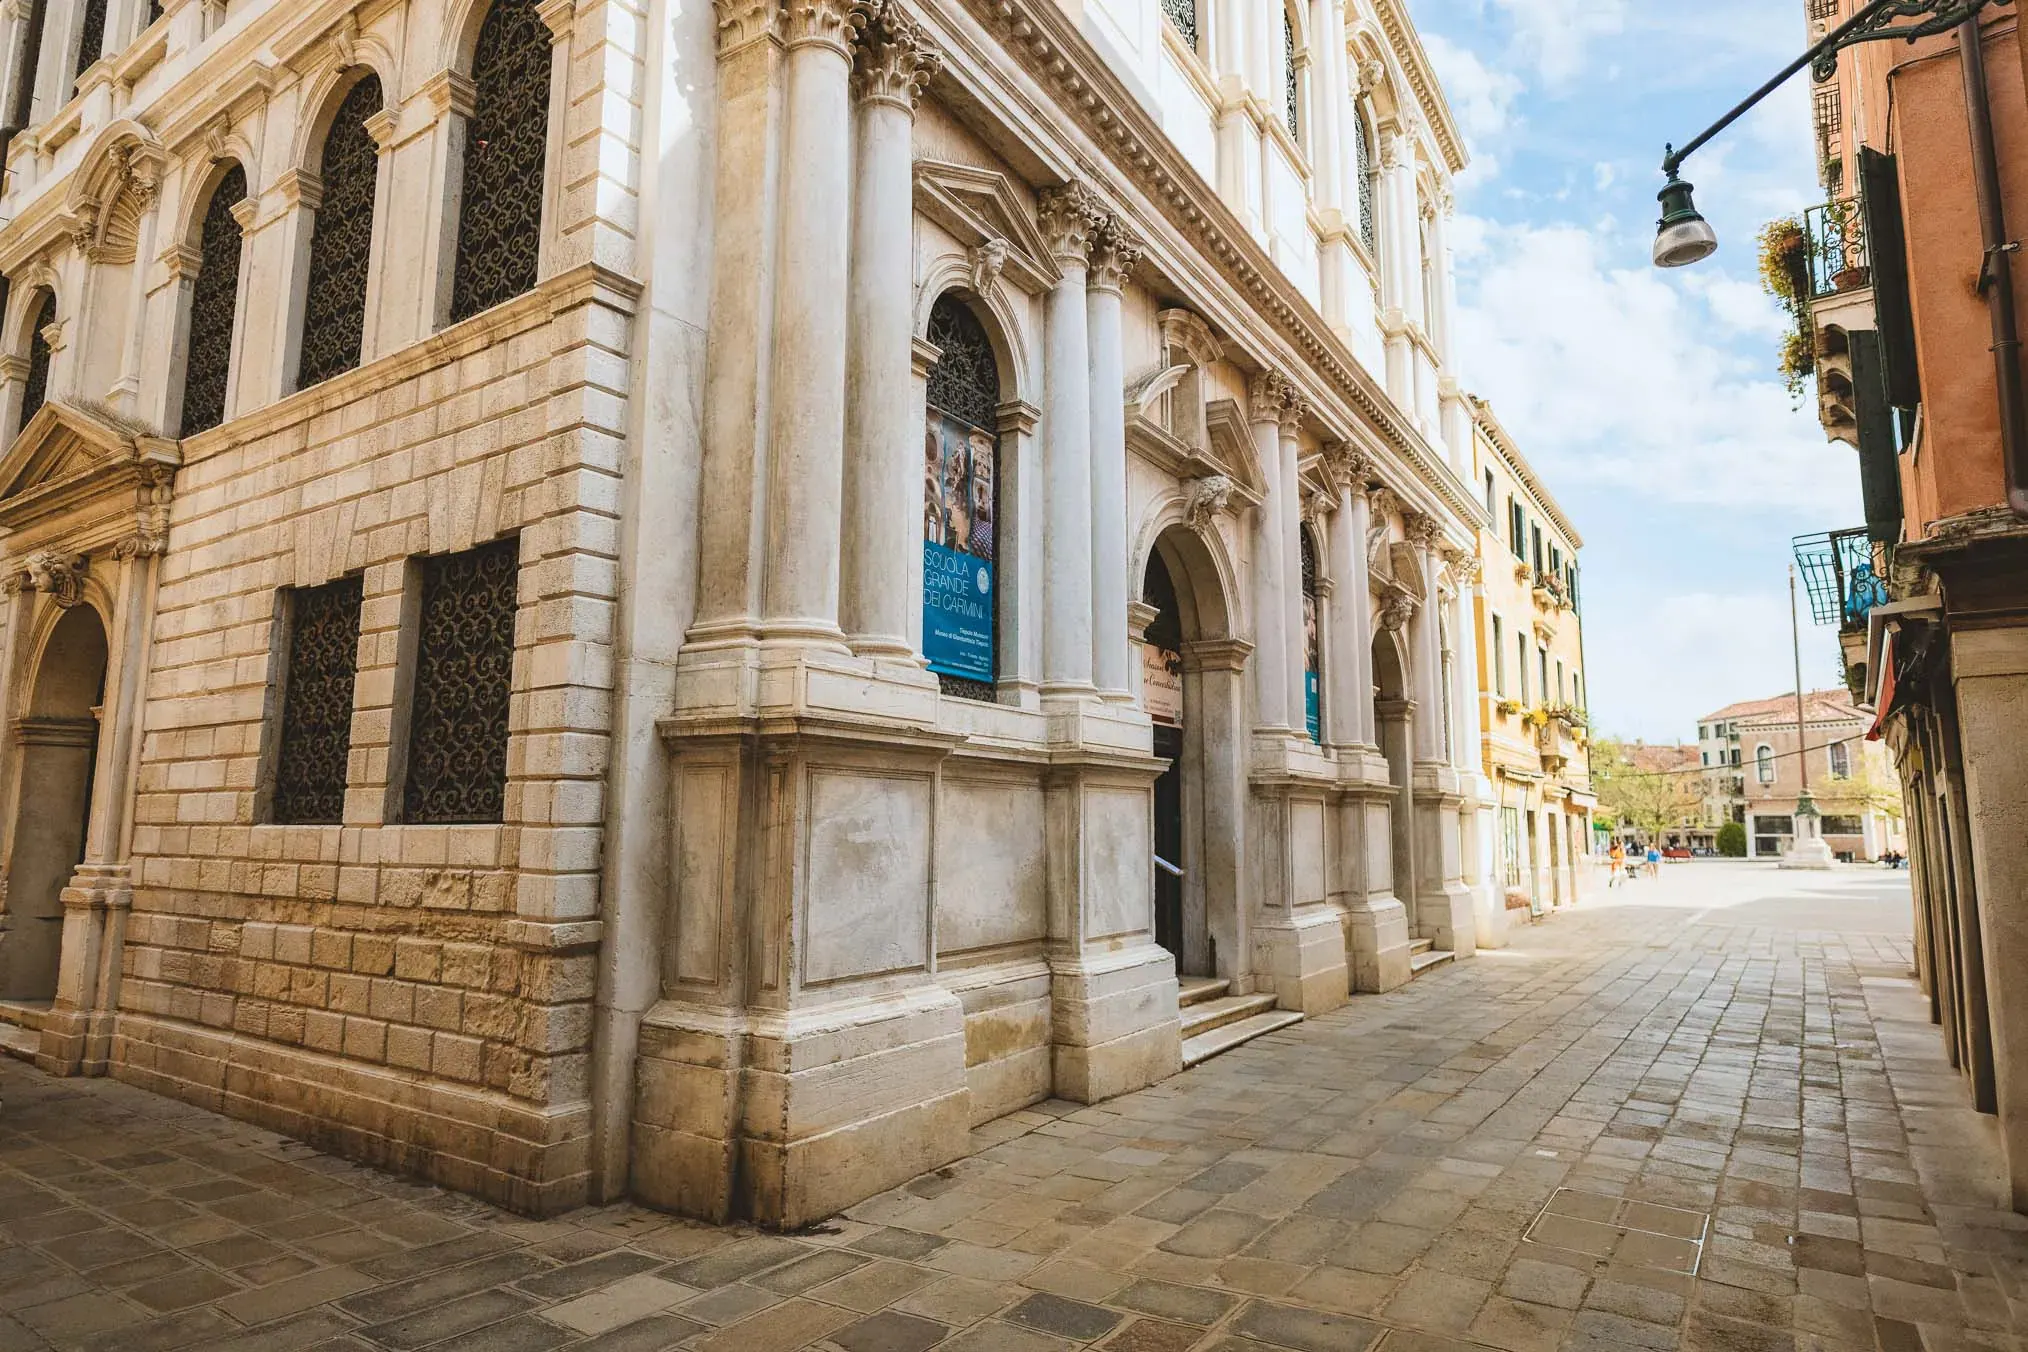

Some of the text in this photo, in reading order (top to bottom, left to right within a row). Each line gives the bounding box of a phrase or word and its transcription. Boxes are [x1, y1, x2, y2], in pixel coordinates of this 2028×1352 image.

[925, 549, 970, 577] SCUOLA
[925, 569, 969, 597] GRANDE
[924, 589, 983, 620] DEI CARMINI
